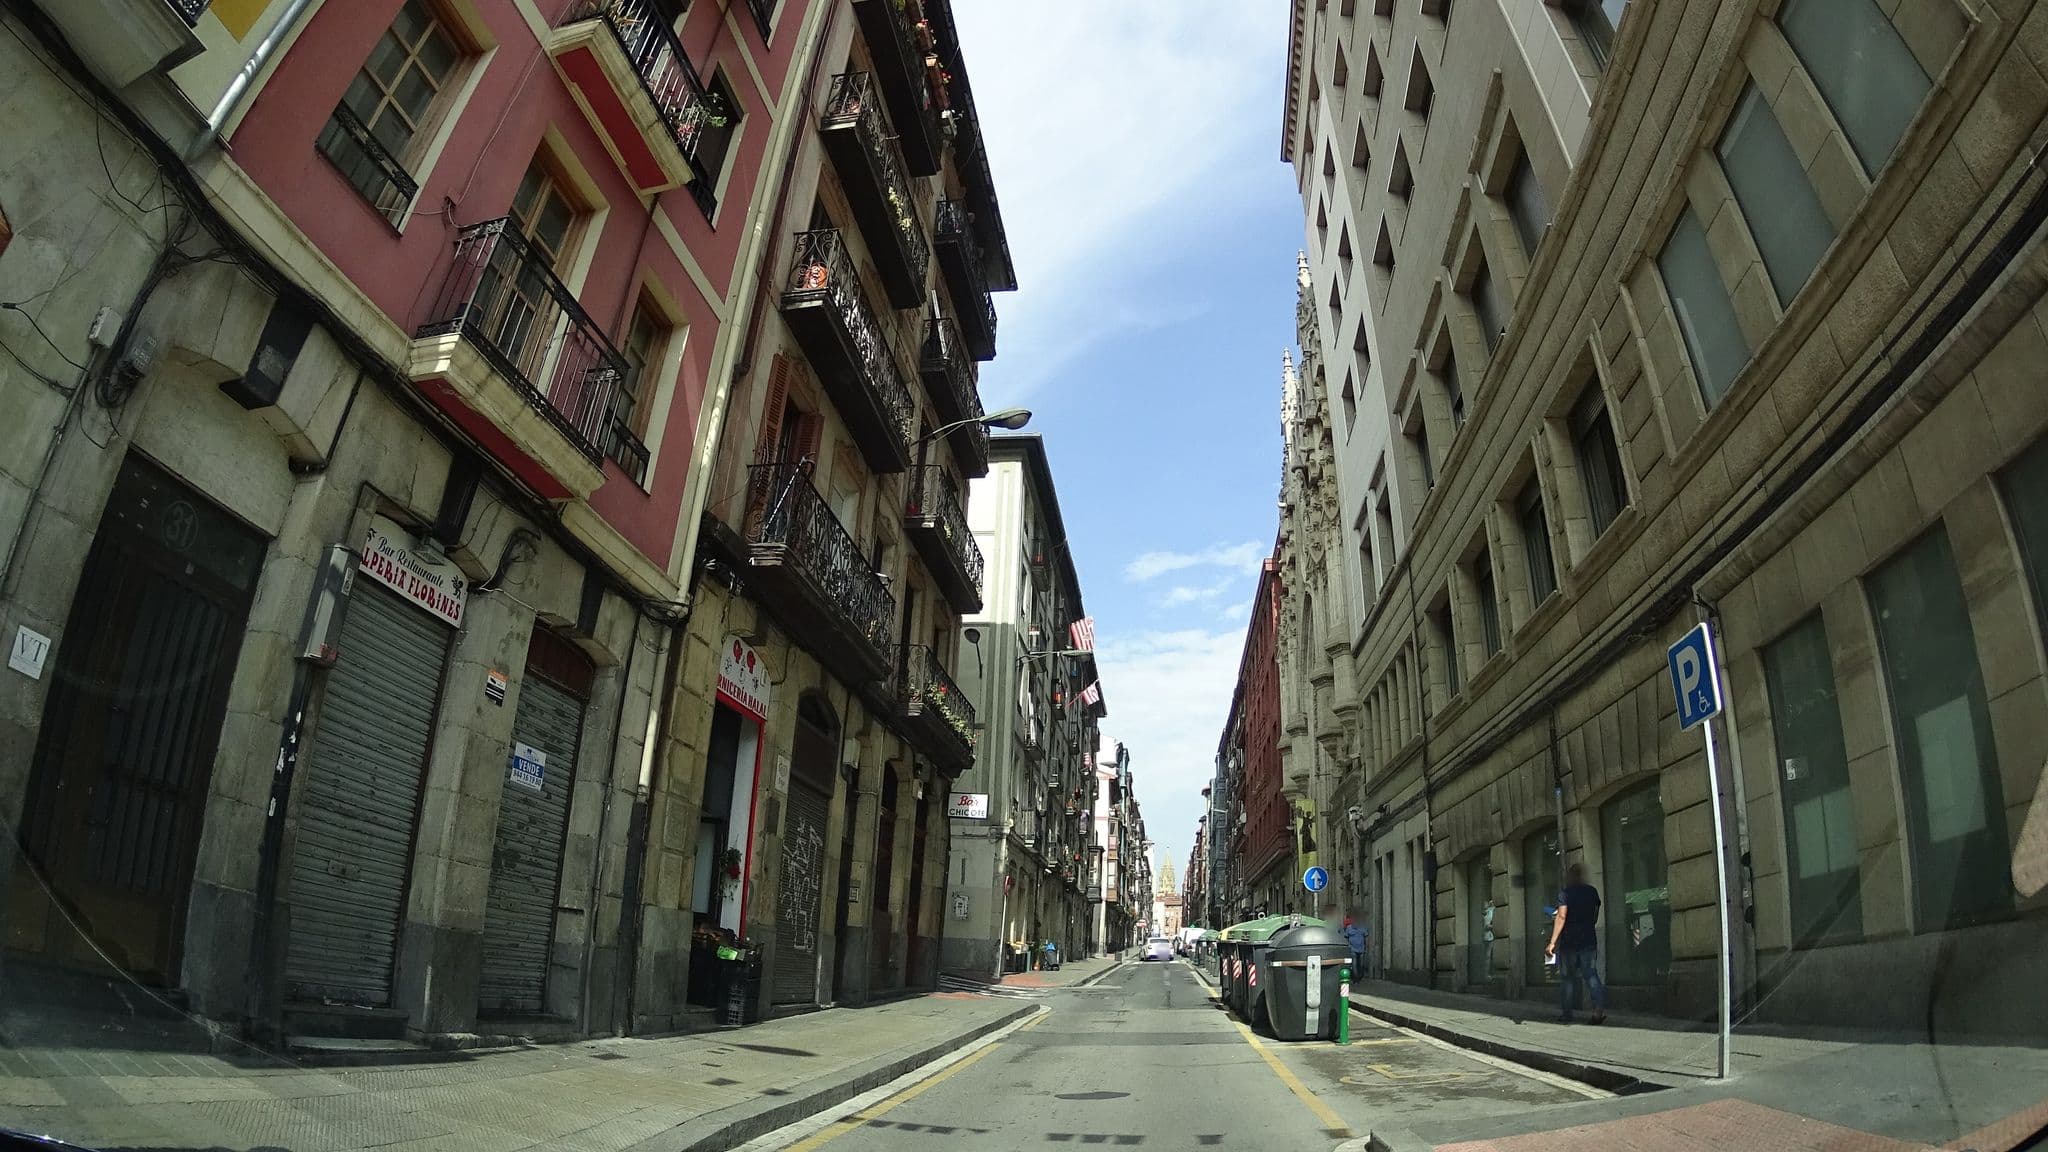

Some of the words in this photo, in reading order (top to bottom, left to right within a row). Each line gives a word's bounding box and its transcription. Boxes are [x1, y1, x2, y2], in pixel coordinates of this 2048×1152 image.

[360, 547, 407, 590] LPERIA
[377, 536, 394, 557] Bar
[398, 548, 444, 588] Restaurante
[20, 632, 47, 662] VT
[1675, 645, 1700, 719] P
[519, 759, 540, 776] VENDE
